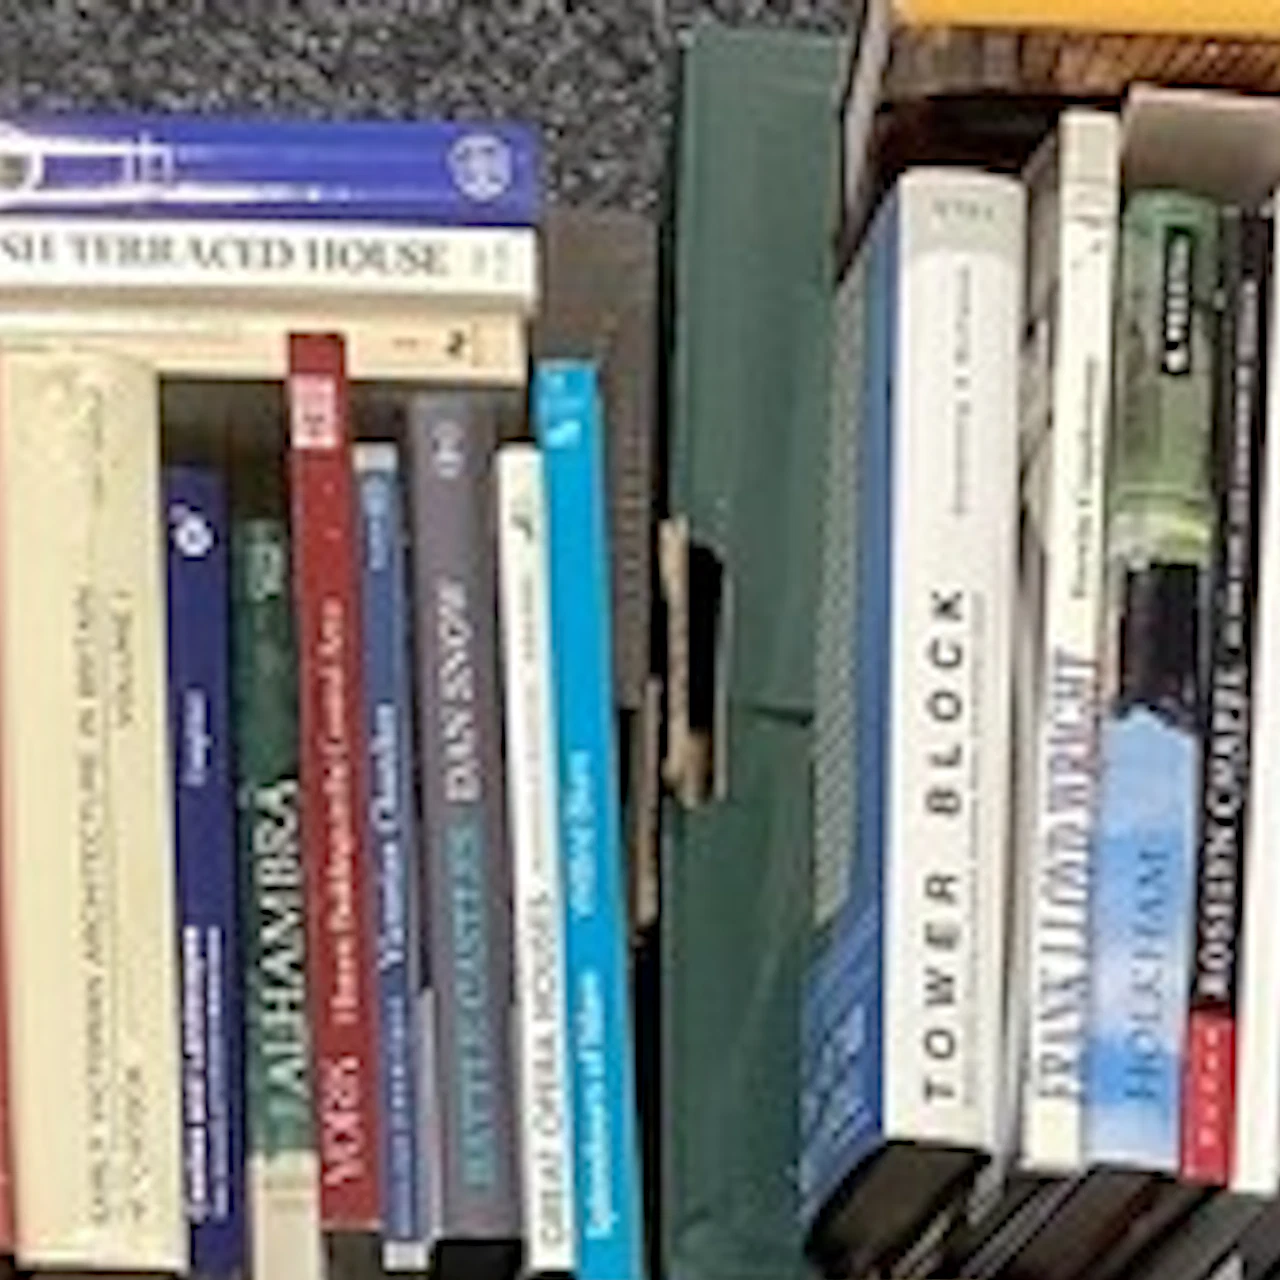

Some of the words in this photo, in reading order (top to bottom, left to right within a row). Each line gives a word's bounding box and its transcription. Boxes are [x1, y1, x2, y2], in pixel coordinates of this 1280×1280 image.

[73, 235, 291, 271] TERRACED
[308, 239, 450, 277] HOUSE
[436, 579, 473, 701] SNOW
[926, 585, 966, 813] BLOCK
[441, 709, 479, 801] DAN
[1045, 647, 1100, 815] WRIGHT
[1206, 659, 1247, 815] CHAPEL
[77, 754, 105, 967] ARCHITECTURE
[1037, 821, 1091, 953] LLOYD
[245, 778, 308, 1094] ALHAMBRA
[526, 891, 557, 1020] HOUSES
[922, 872, 960, 1106] TOWER
[1119, 846, 1168, 1101] HOLKHAM
[531, 1033, 561, 1138] OPERA
[1033, 961, 1087, 1100] FRANK
[323, 1055, 364, 1186] YORK
[460, 1020, 496, 1187] BATTLE
[534, 1150, 564, 1246] GREAT
